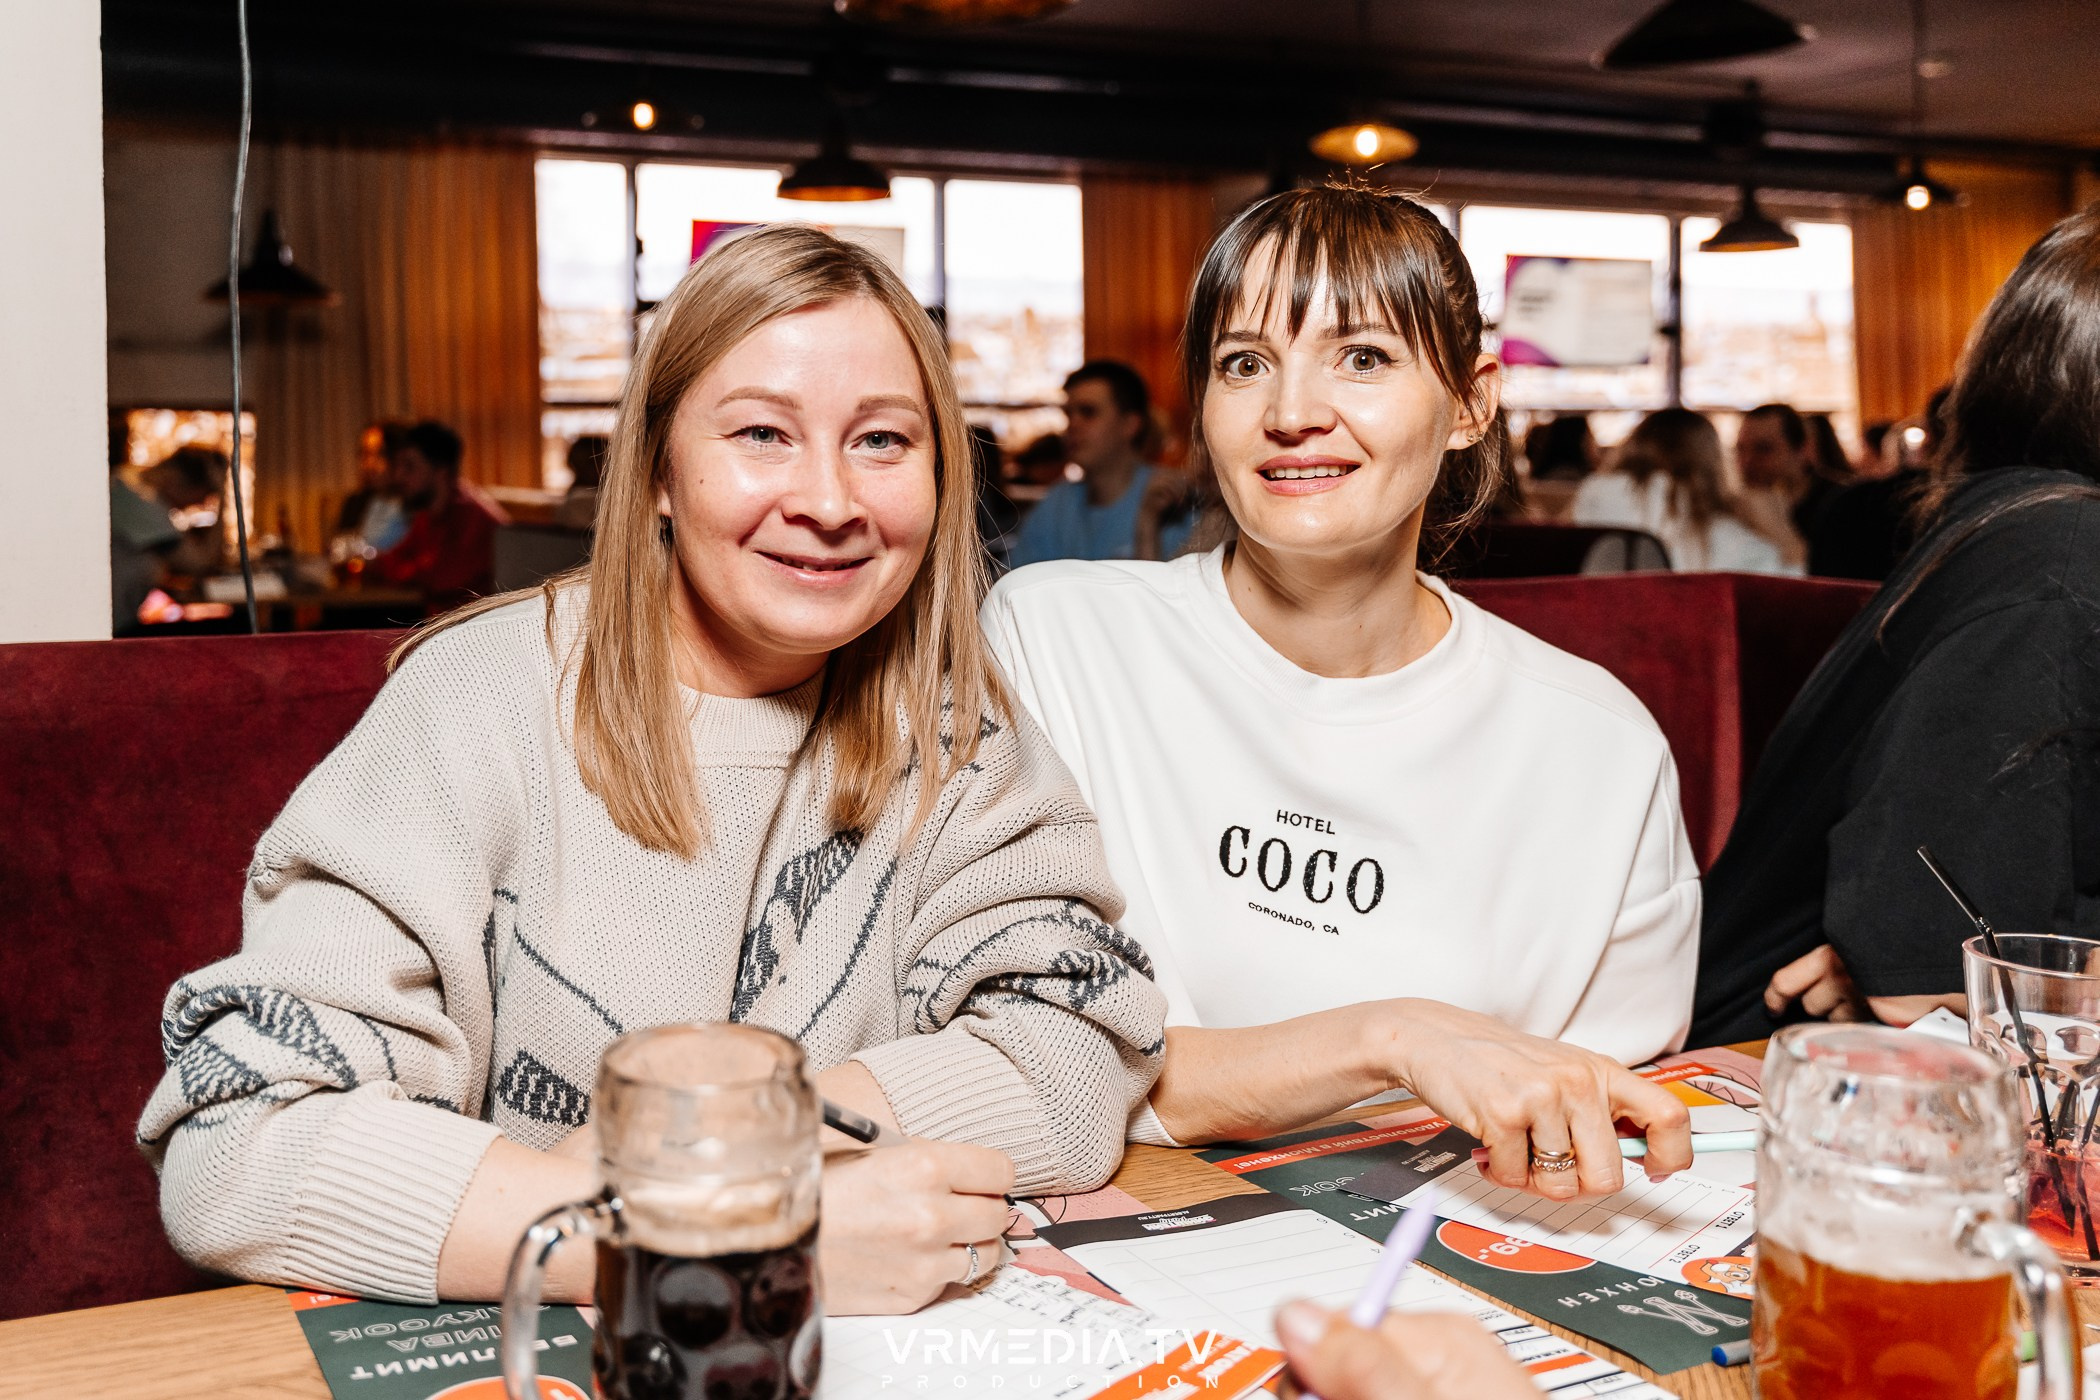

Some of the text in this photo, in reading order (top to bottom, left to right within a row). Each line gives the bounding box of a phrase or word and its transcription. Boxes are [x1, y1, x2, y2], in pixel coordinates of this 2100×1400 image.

[1276, 809, 1336, 835] HOTEL
[1219, 825, 1385, 914] COCO
[1248, 901, 1340, 936] CORONADO, CA
[1349, 1203, 1408, 1221] МИТ
[1720, 1211, 1745, 1227] ОТВЕТ
[1674, 1244, 1700, 1260] ОТВЕТ
[1557, 1275, 1665, 1308] ЮНХЕН
[329, 1305, 550, 1343] КУСОК
[350, 1347, 496, 1380] ЛИМИТ
